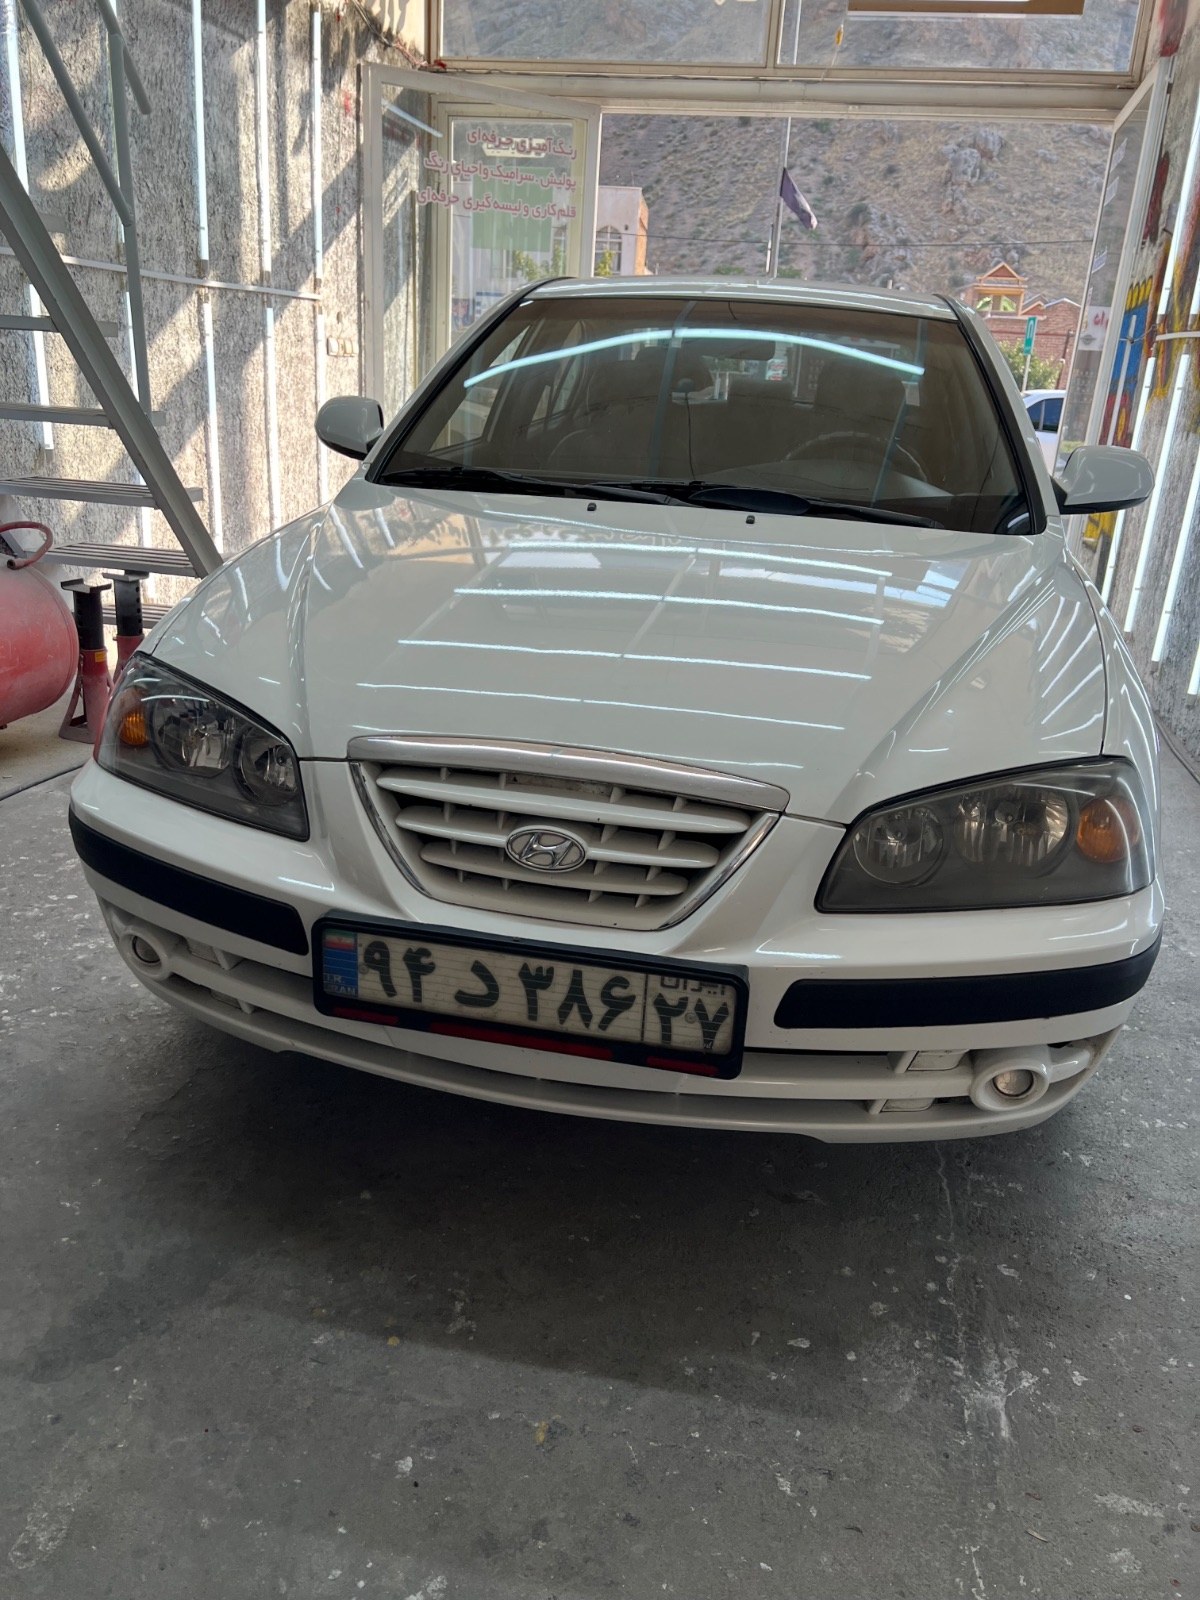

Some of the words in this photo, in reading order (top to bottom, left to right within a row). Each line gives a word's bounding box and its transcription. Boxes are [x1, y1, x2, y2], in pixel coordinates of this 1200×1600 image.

[424, 152, 449, 173] رنگ
[491, 164, 535, 185] سرامیک
[541, 171, 577, 192] پولیش
[654, 992, 730, 1050] ۲۷
